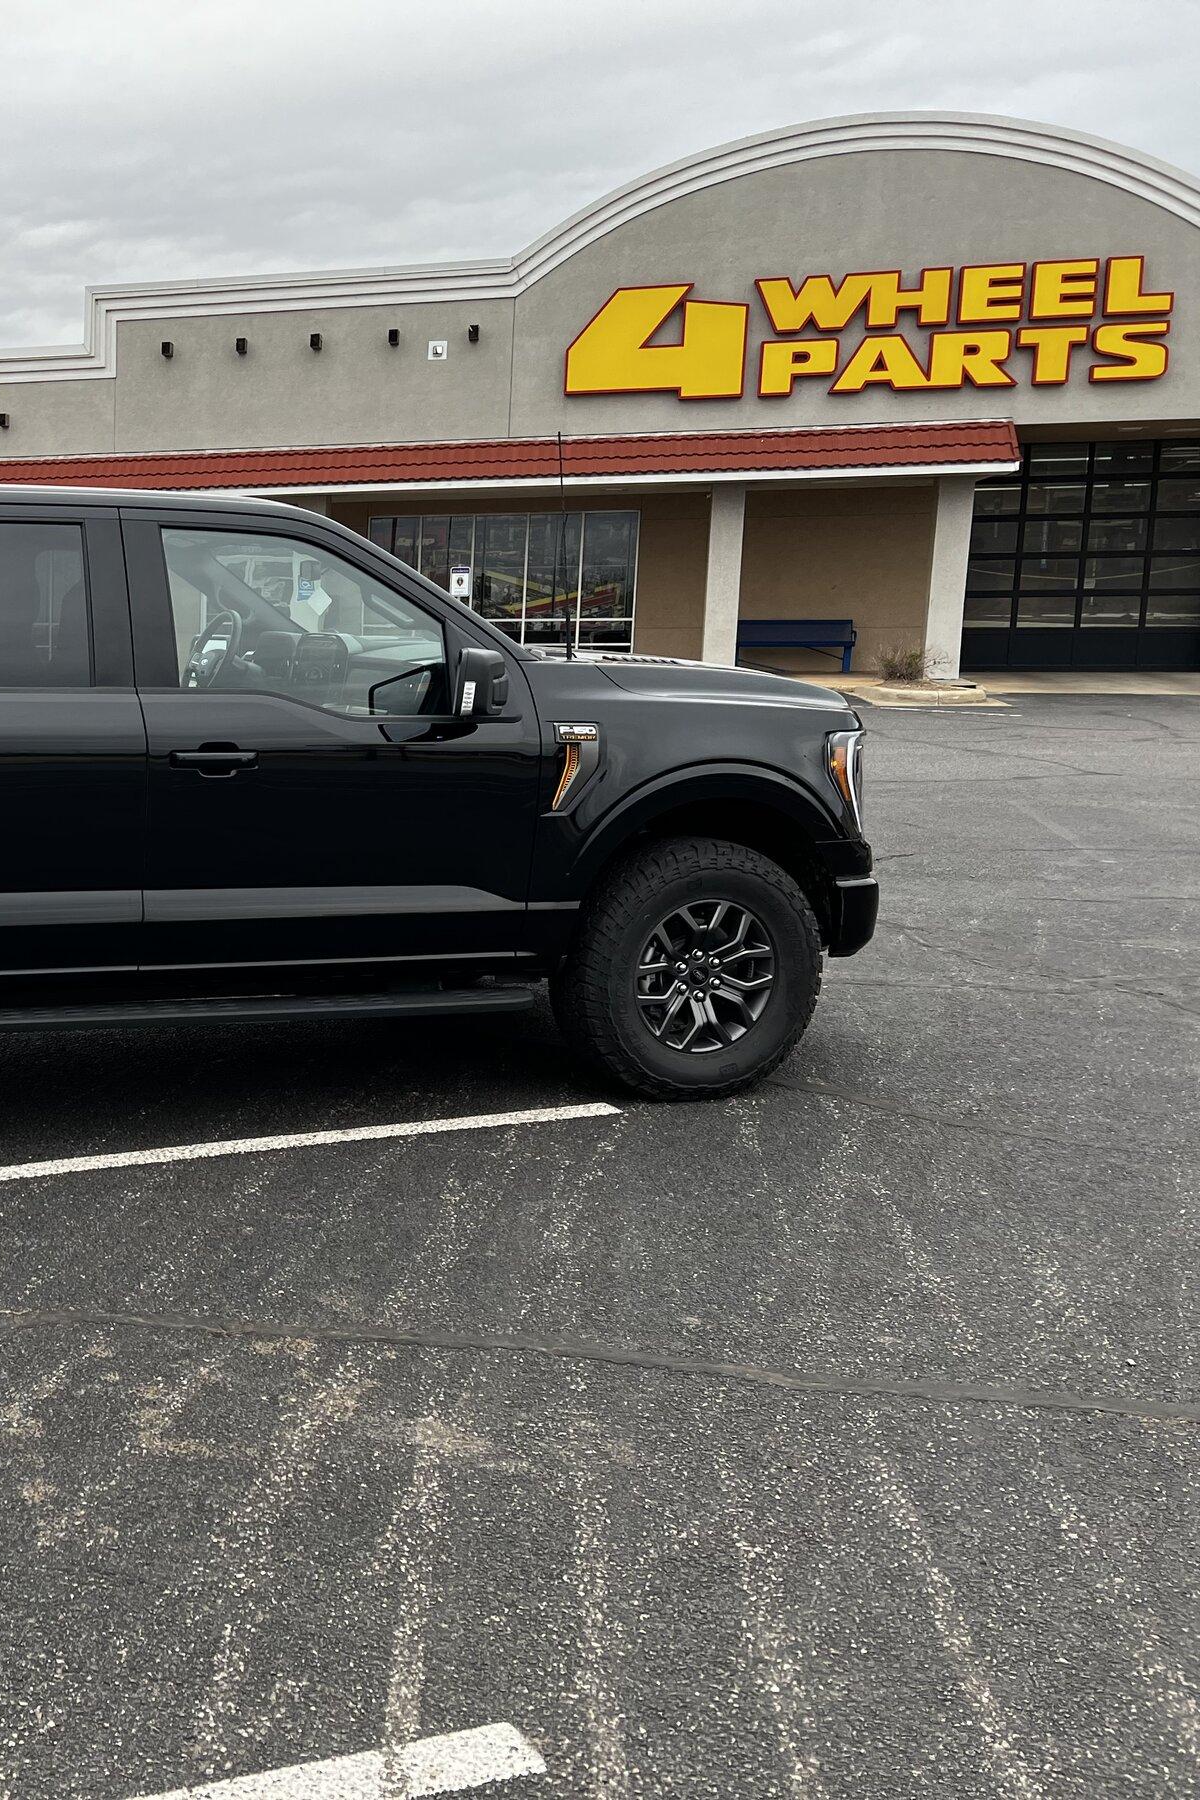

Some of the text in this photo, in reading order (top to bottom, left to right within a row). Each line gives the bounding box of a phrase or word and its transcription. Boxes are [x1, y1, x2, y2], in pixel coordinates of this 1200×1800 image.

[564, 255, 1175, 401] 4 WHEEL
[756, 320, 1171, 399] PARTS
[559, 726, 597, 735] F-150
